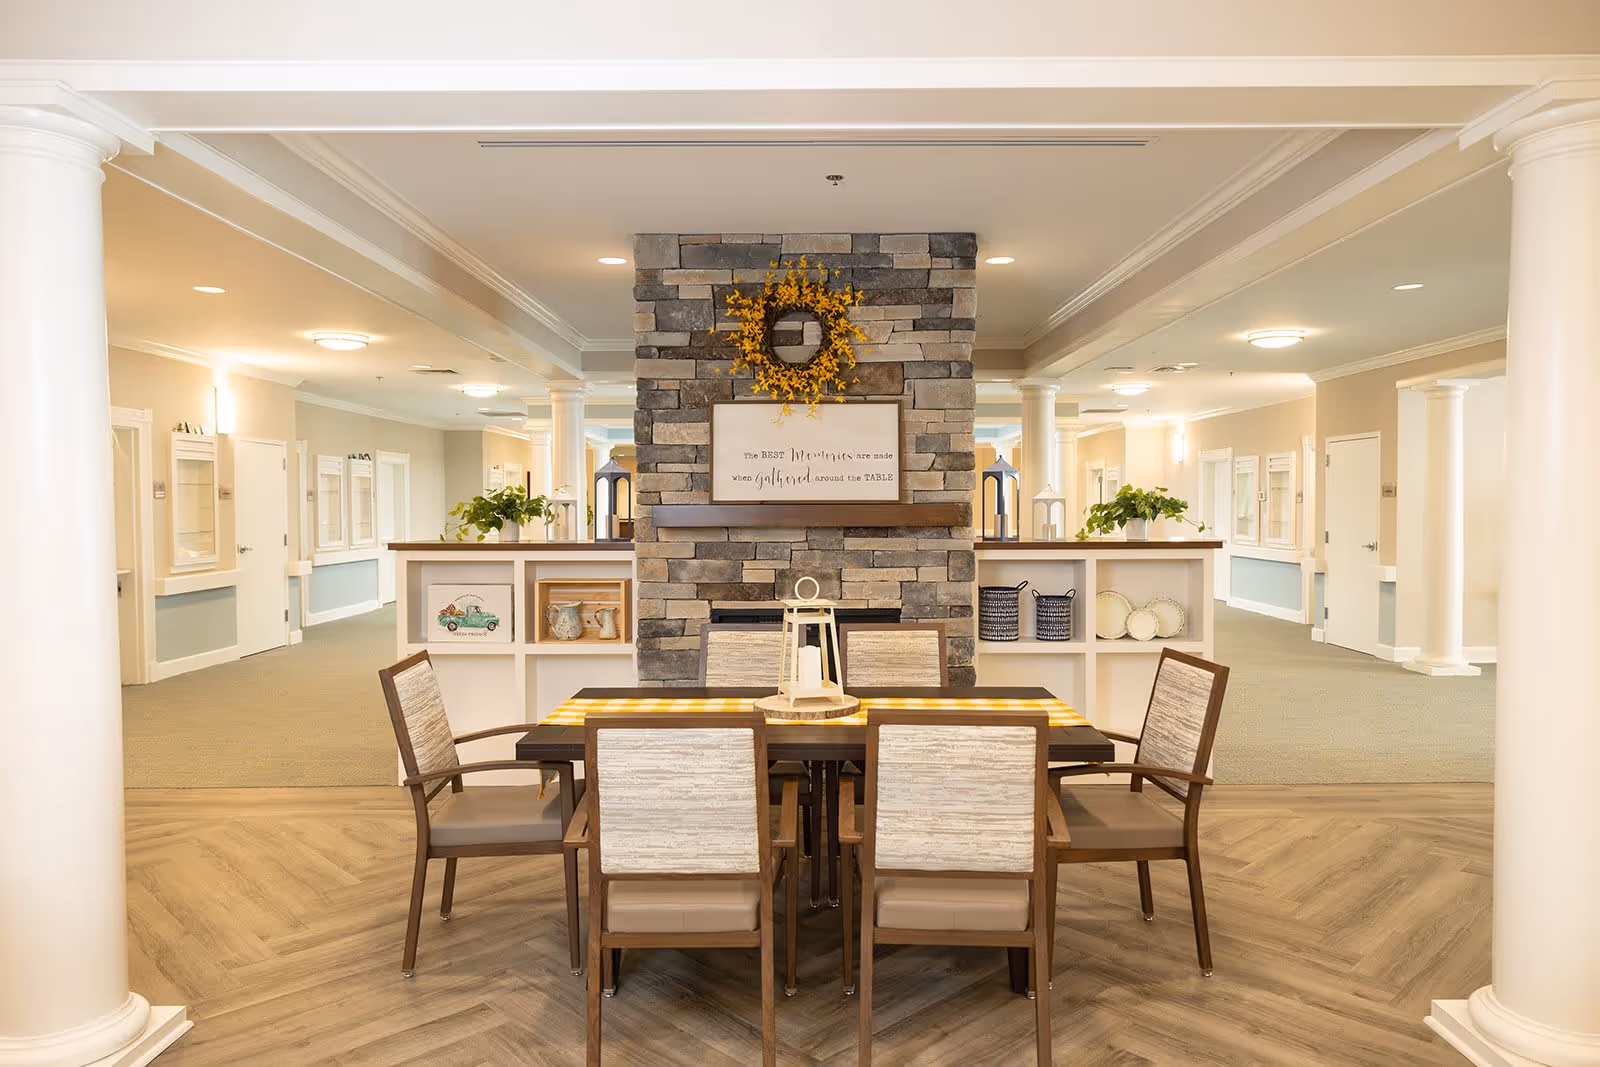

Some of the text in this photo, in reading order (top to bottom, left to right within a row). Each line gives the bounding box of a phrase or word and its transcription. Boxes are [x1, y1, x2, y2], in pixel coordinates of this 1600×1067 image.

[744, 451, 759, 460] The
[761, 450, 785, 459] BEST
[789, 447, 853, 463] Memories
[873, 452, 894, 460] made
[732, 474, 752, 482] when
[814, 474, 844, 482] around
[847, 474, 862, 482] the
[864, 473, 894, 482] TABLE
